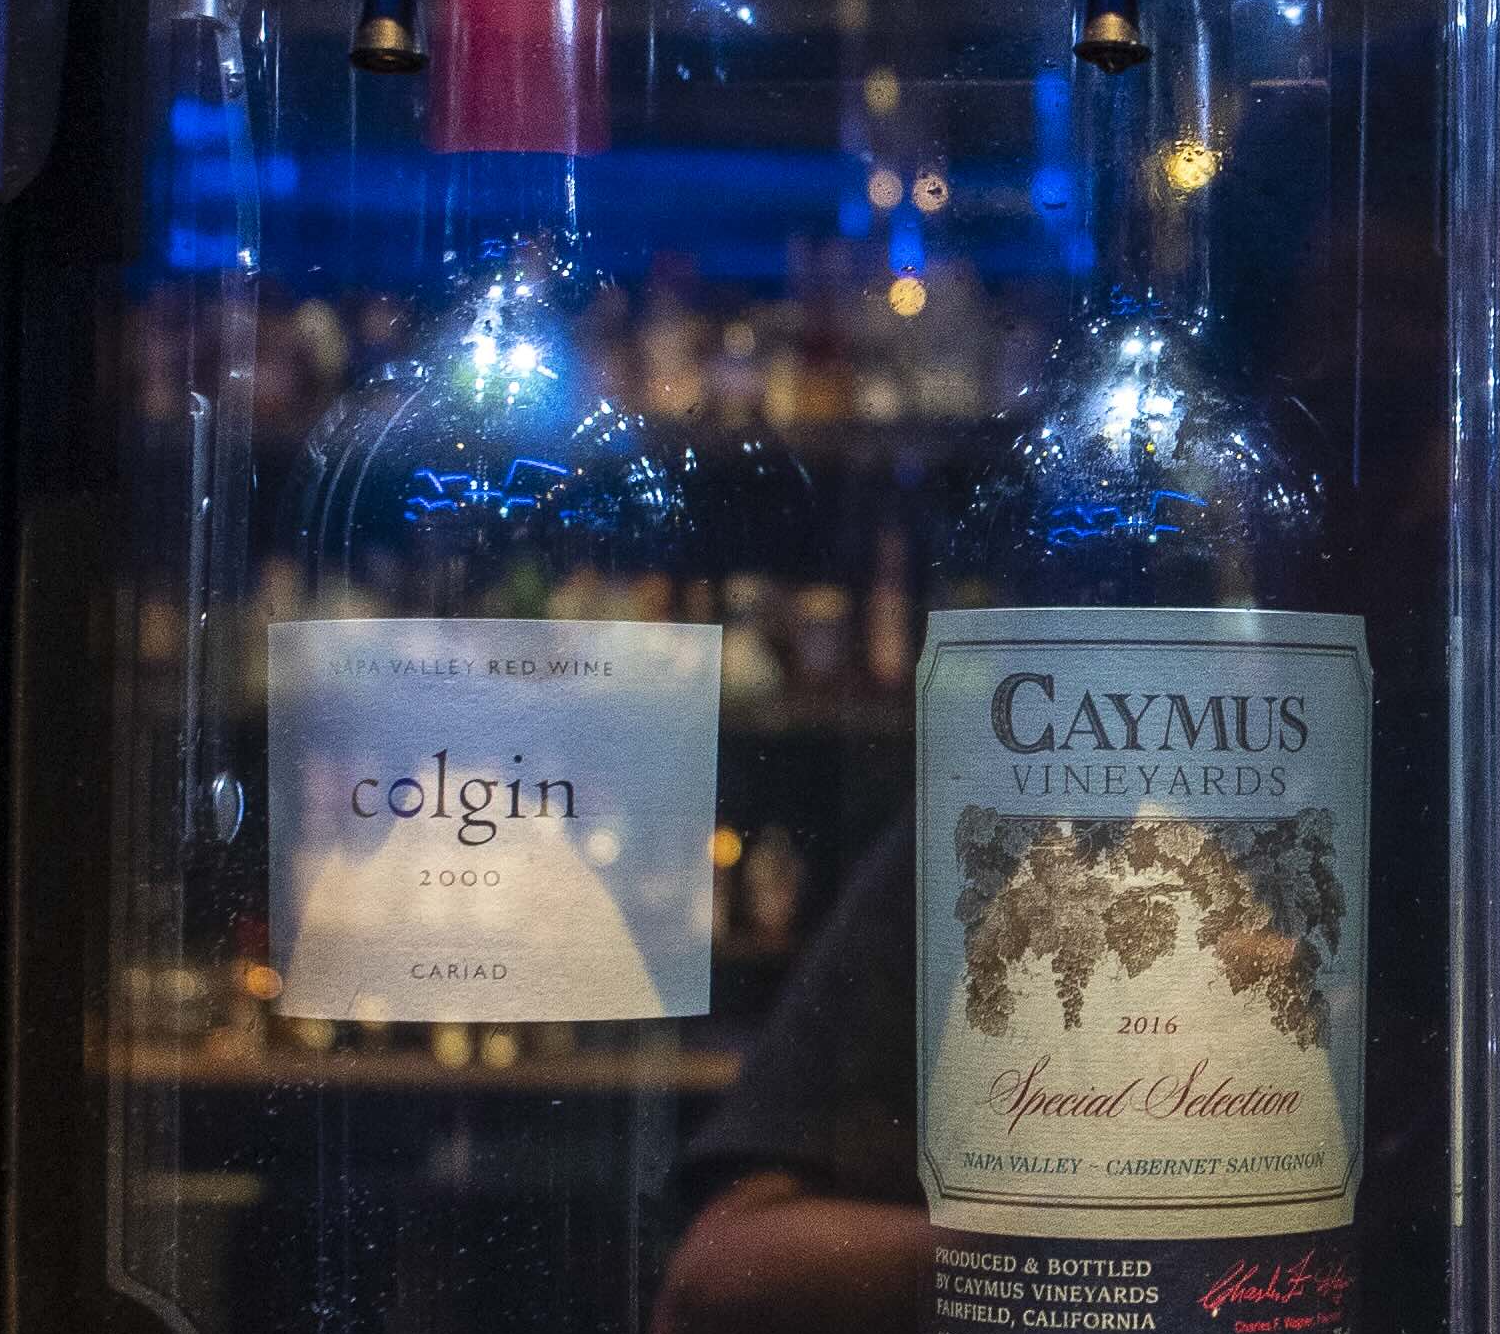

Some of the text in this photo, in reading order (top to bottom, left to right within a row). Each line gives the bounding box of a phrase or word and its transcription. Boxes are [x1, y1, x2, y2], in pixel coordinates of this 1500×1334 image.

[393, 659, 474, 676] VALLEY
[487, 659, 537, 676] RED
[549, 660, 613, 677] WINE
[990, 671, 1309, 754] CAYMUS
[1011, 764, 1288, 797] VINEYARDS
[351, 748, 580, 846] colgin
[418, 869, 501, 888] 2000
[410, 962, 509, 982] CARIAD
[1116, 1015, 1179, 1036] 2016
[986, 1053, 1301, 1136] Special Selection
[962, 1152, 1003, 1172] NAPA
[1008, 1156, 1083, 1175] VALLEY
[1105, 1158, 1222, 1177] CABERNET
[1225, 1151, 1326, 1174] SAUVIGNON
[935, 1246, 1152, 1278] PRODUCED & BOTTLED
[935, 1272, 1159, 1305] BY CAYMUS VINEYARDS
[936, 1297, 1157, 1331] FAIRFIELD, CALIFORNIA
